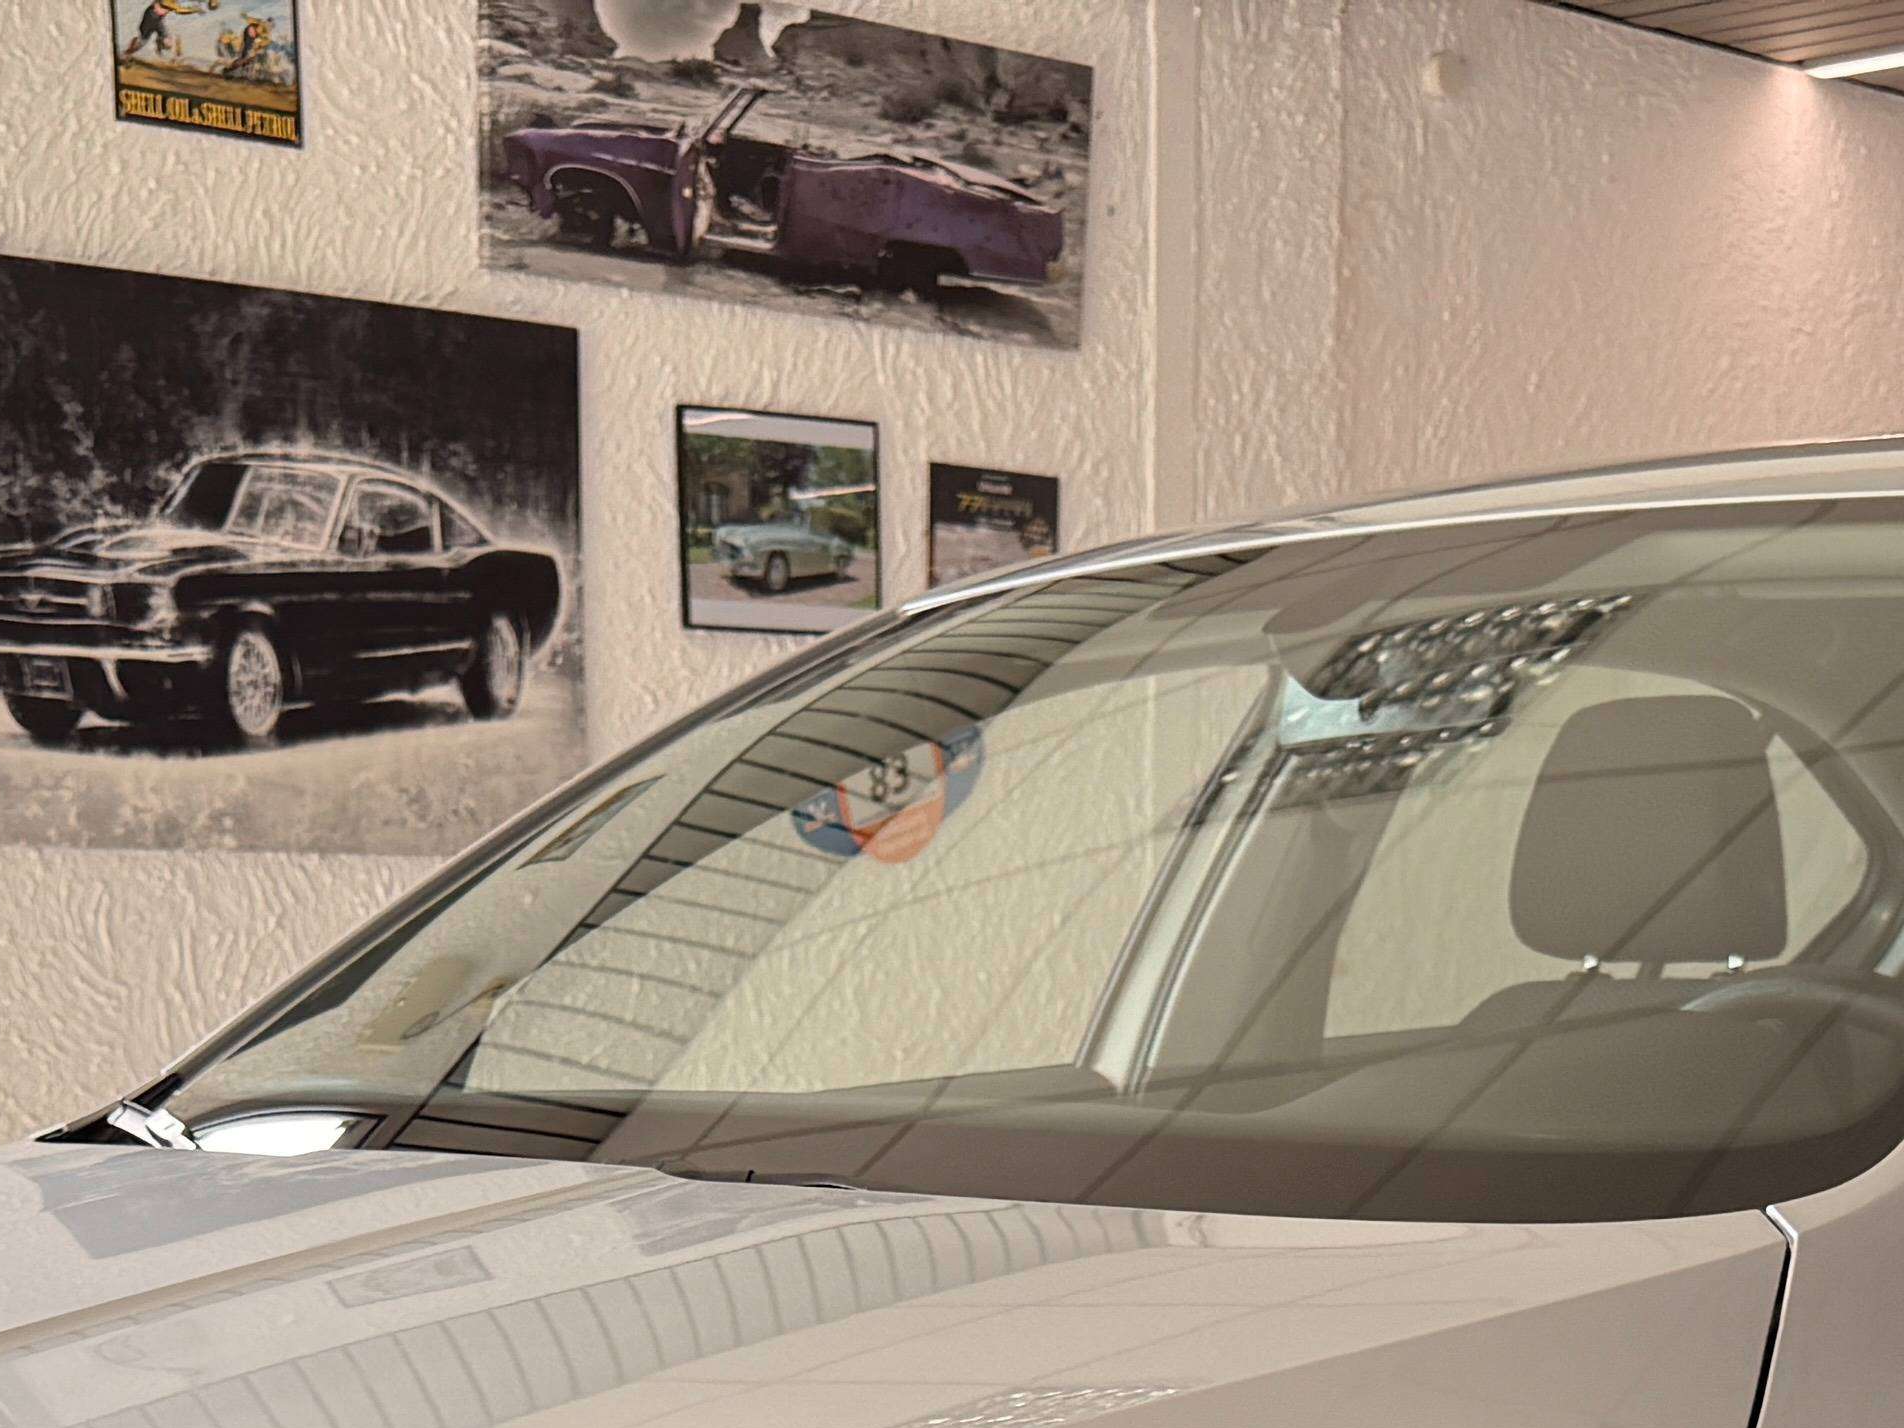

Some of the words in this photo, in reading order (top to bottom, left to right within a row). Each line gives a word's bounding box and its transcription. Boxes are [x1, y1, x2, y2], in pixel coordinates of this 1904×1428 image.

[121, 89, 166, 120] SHELL
[166, 97, 192, 122] OIL
[200, 102, 246, 132] SHELL
[246, 109, 297, 142] PETROL
[870, 753, 909, 803] 83
